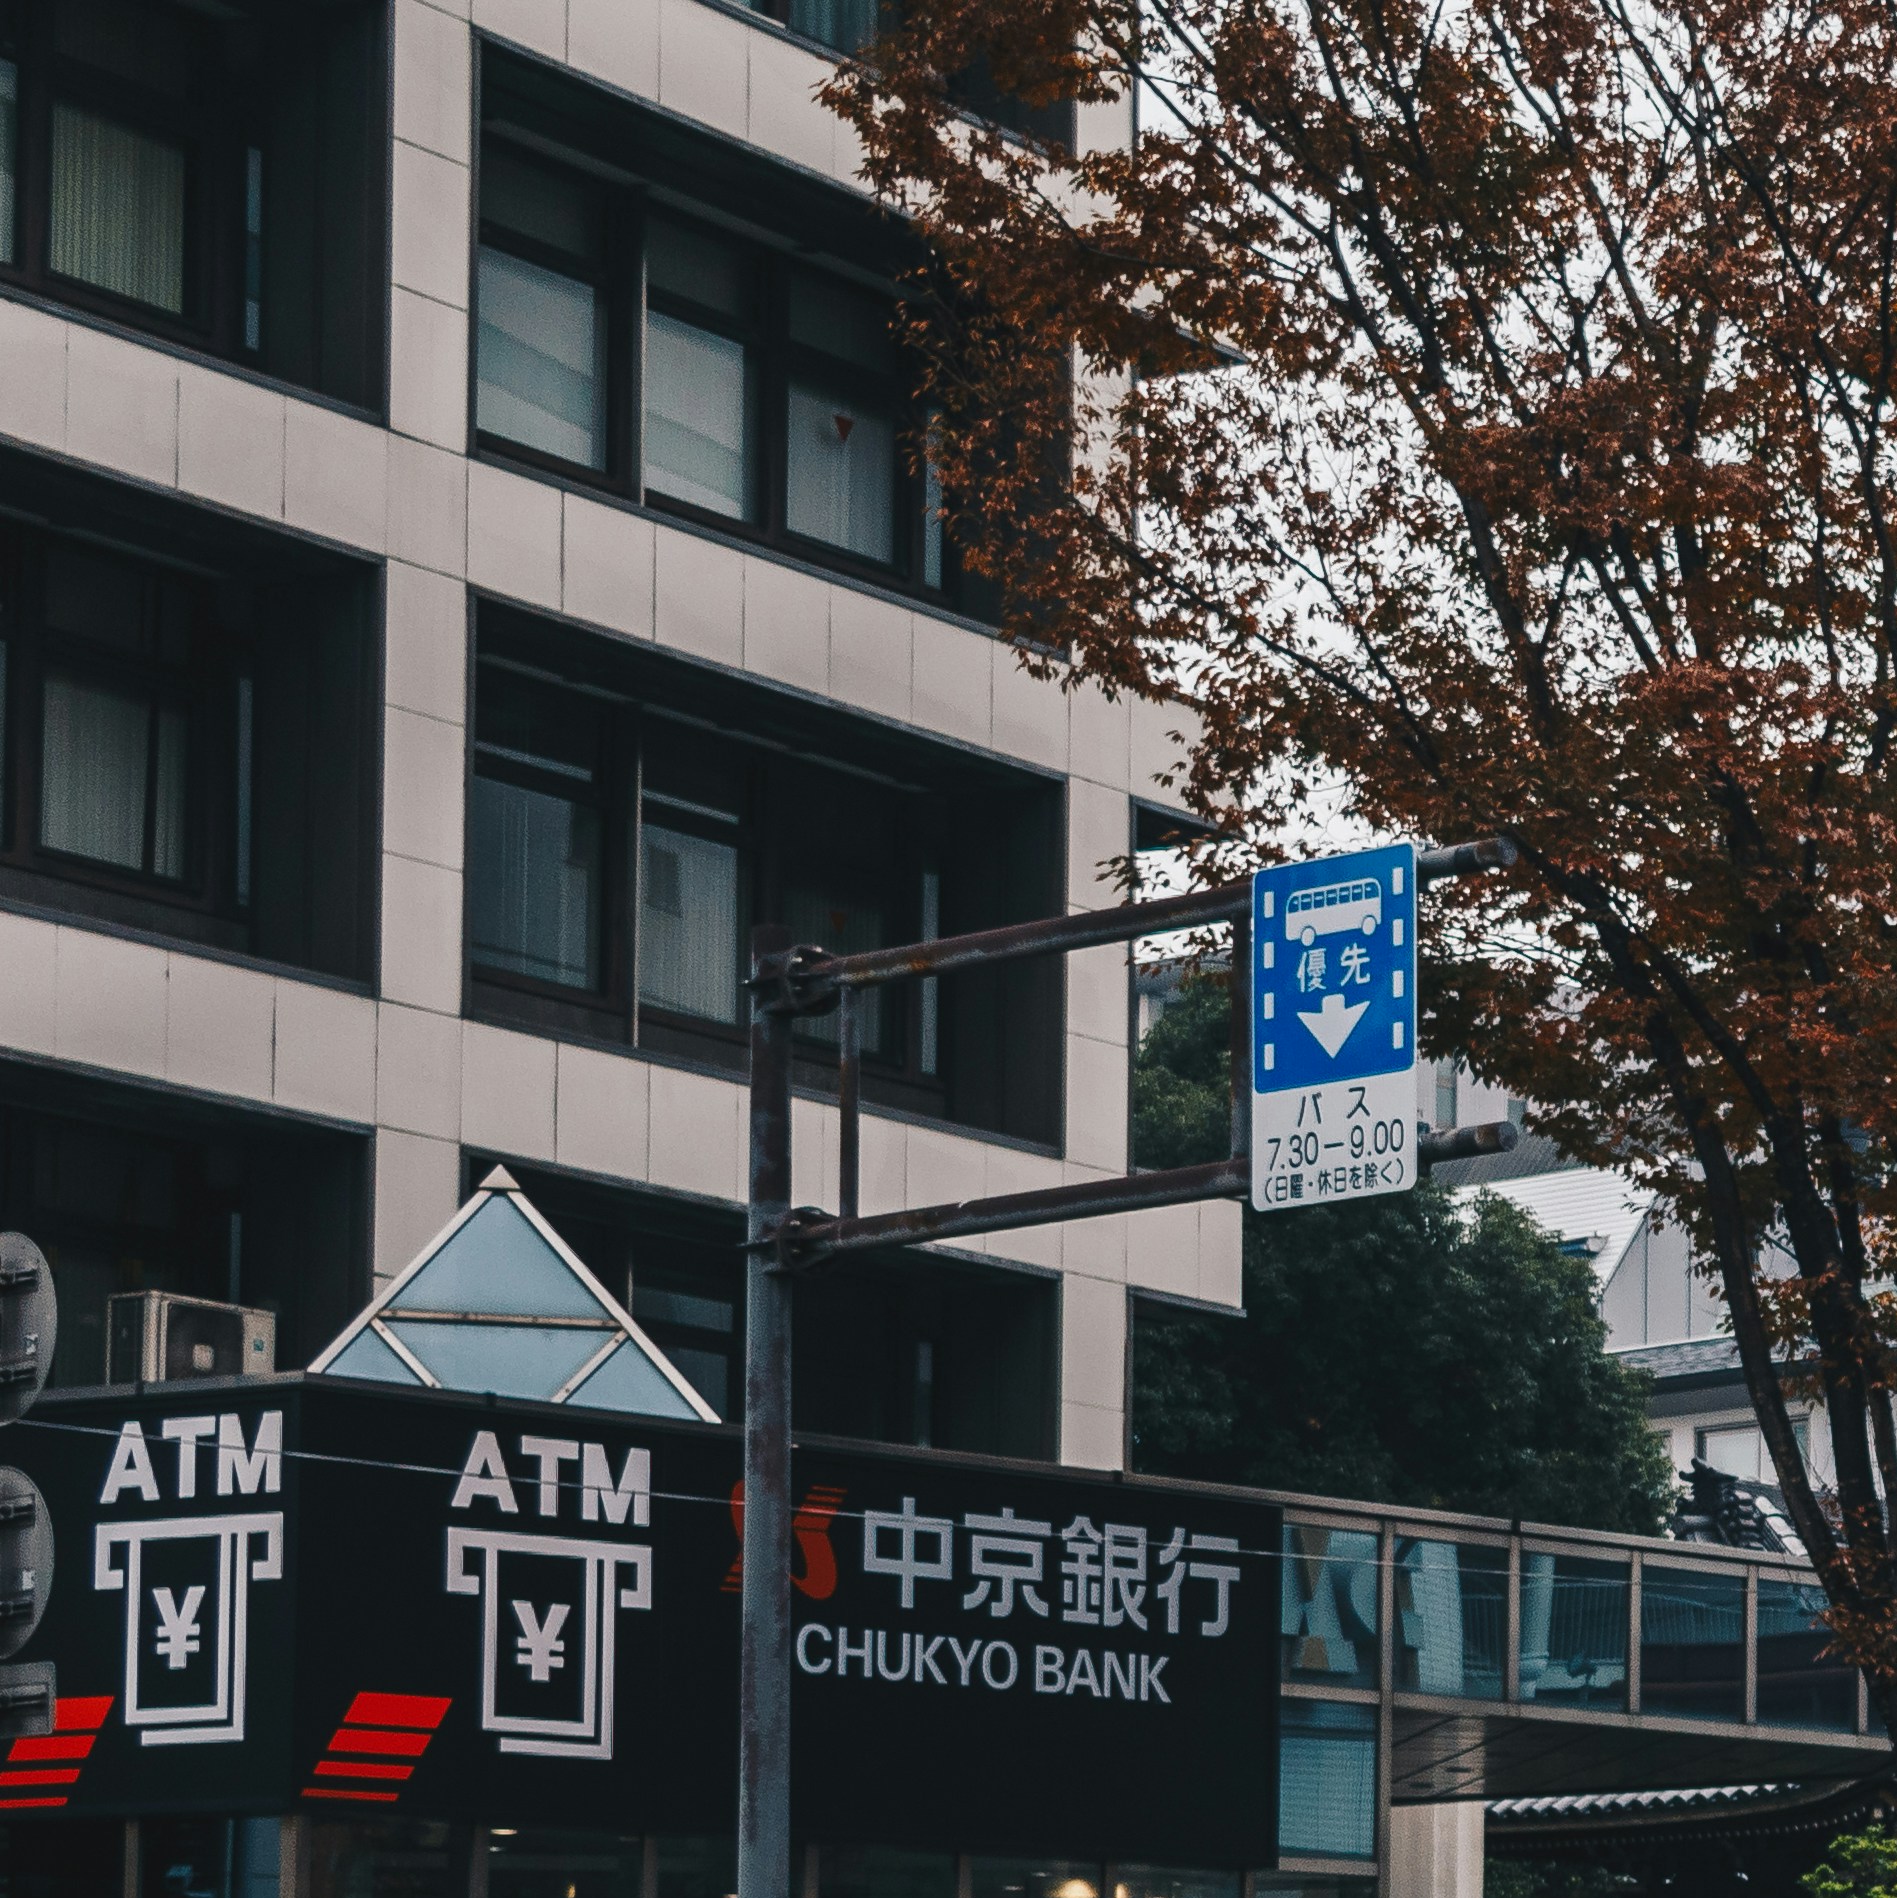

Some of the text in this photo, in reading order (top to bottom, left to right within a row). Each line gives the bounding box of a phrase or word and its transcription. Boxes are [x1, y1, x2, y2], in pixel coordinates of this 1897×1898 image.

[1296, 942, 1371, 993] 優先
[1297, 1085, 1371, 1128] バス
[100, 1409, 284, 1505] ATM
[451, 1430, 651, 1527] ATM
[863, 1497, 1241, 1637] 中京銀行
[796, 1623, 1172, 1703] CHUKYO BANK
